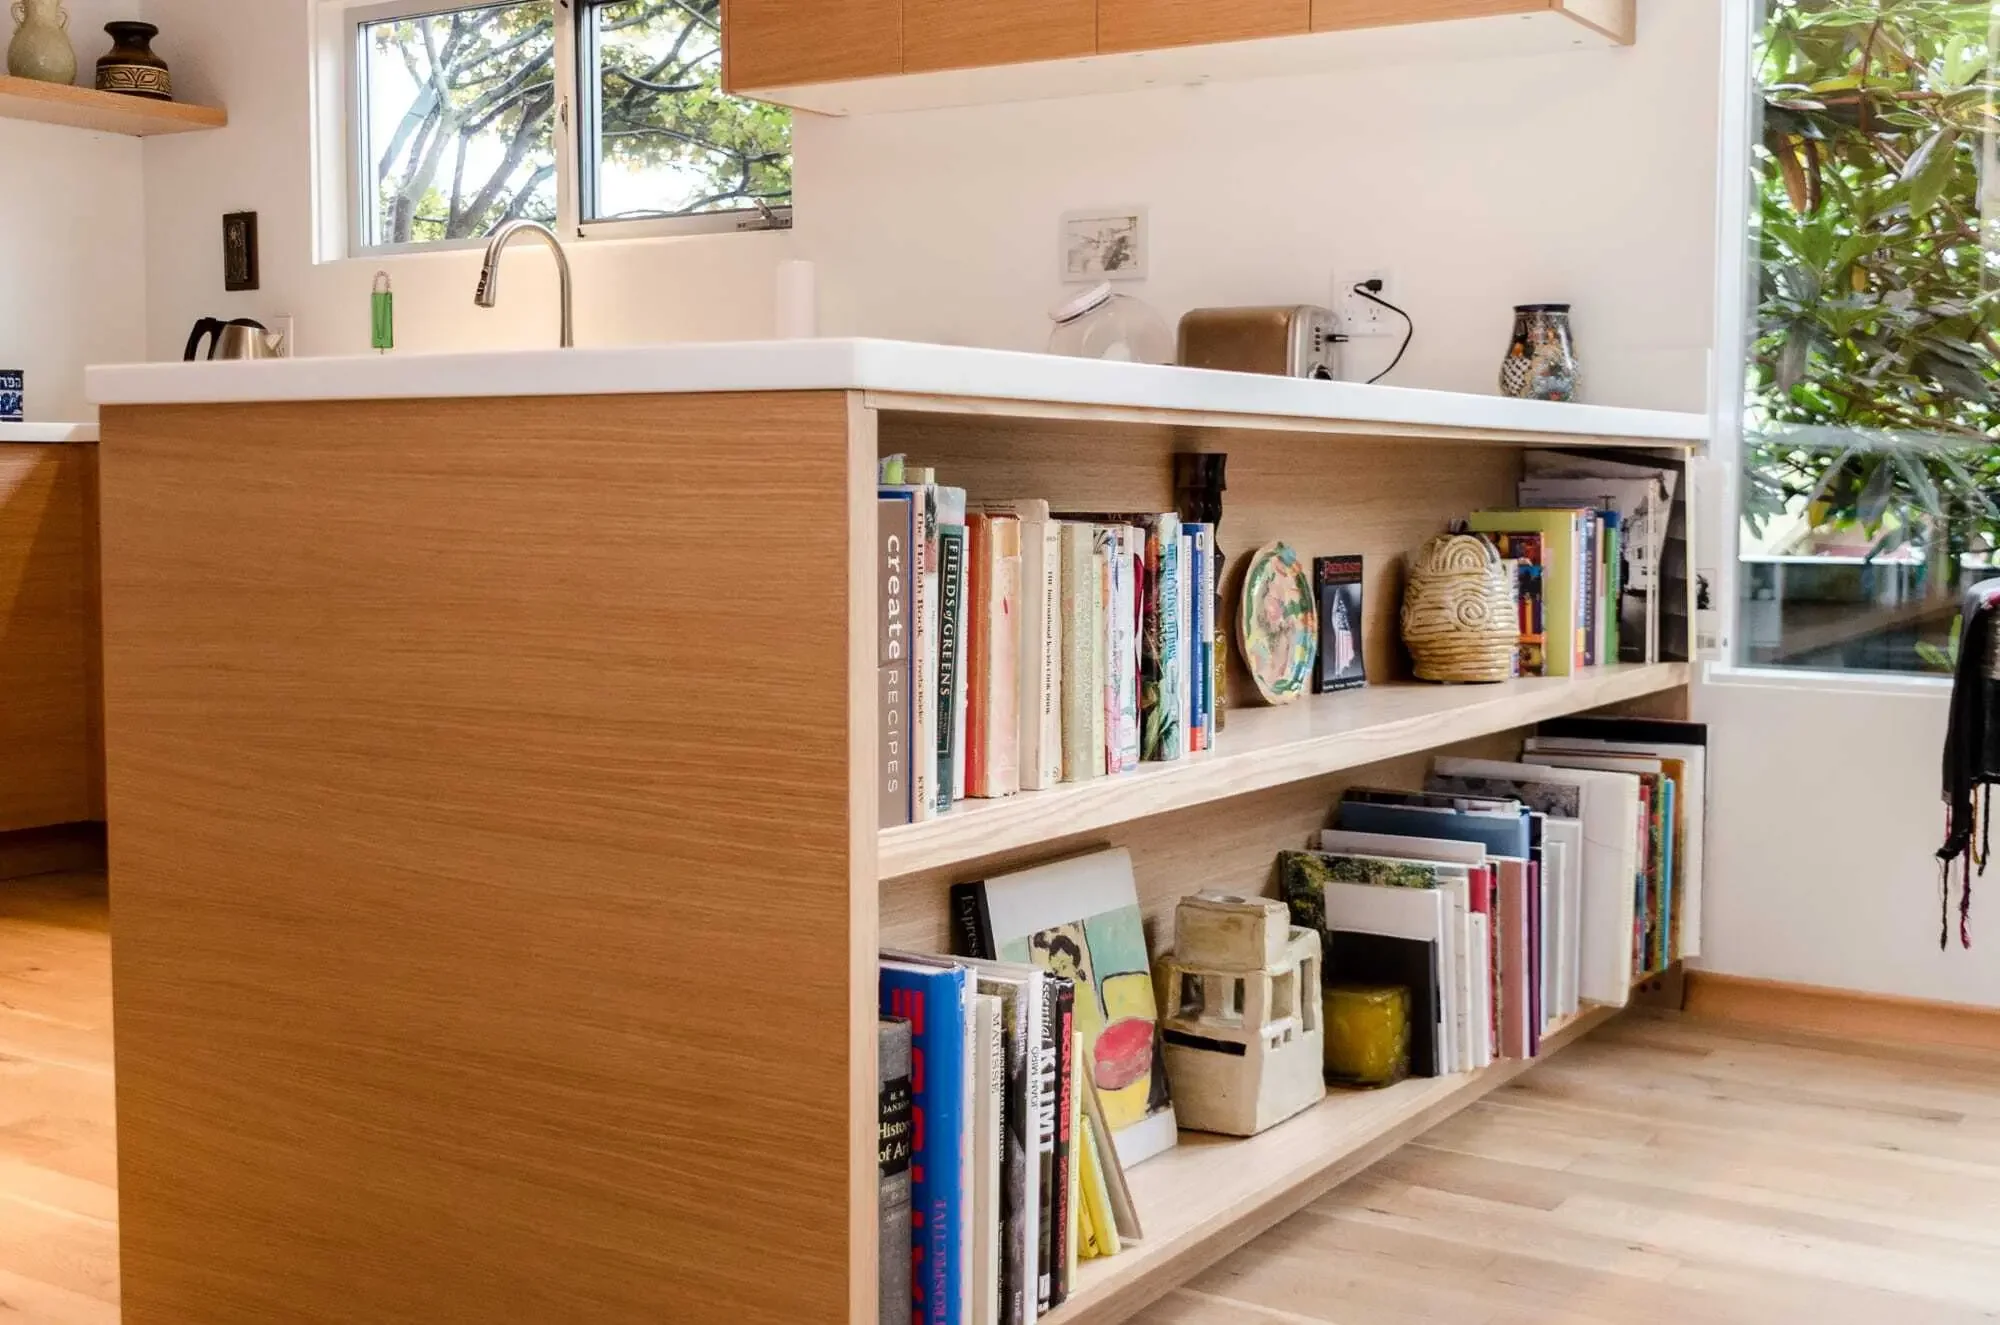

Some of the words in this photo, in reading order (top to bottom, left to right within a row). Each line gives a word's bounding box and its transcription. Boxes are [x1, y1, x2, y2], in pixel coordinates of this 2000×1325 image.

[887, 534, 901, 660] create
[943, 608, 955, 622] of
[944, 543, 958, 607] FIELDS
[939, 623, 953, 697] GREENS
[887, 670, 899, 794] RECIPES
[991, 1012, 1001, 1094] MATISSE
[1061, 1012, 1072, 1073] EGON
[1040, 1046, 1056, 1153] KLIMT
[1058, 1155, 1068, 1269] SKETCHBOOKS
